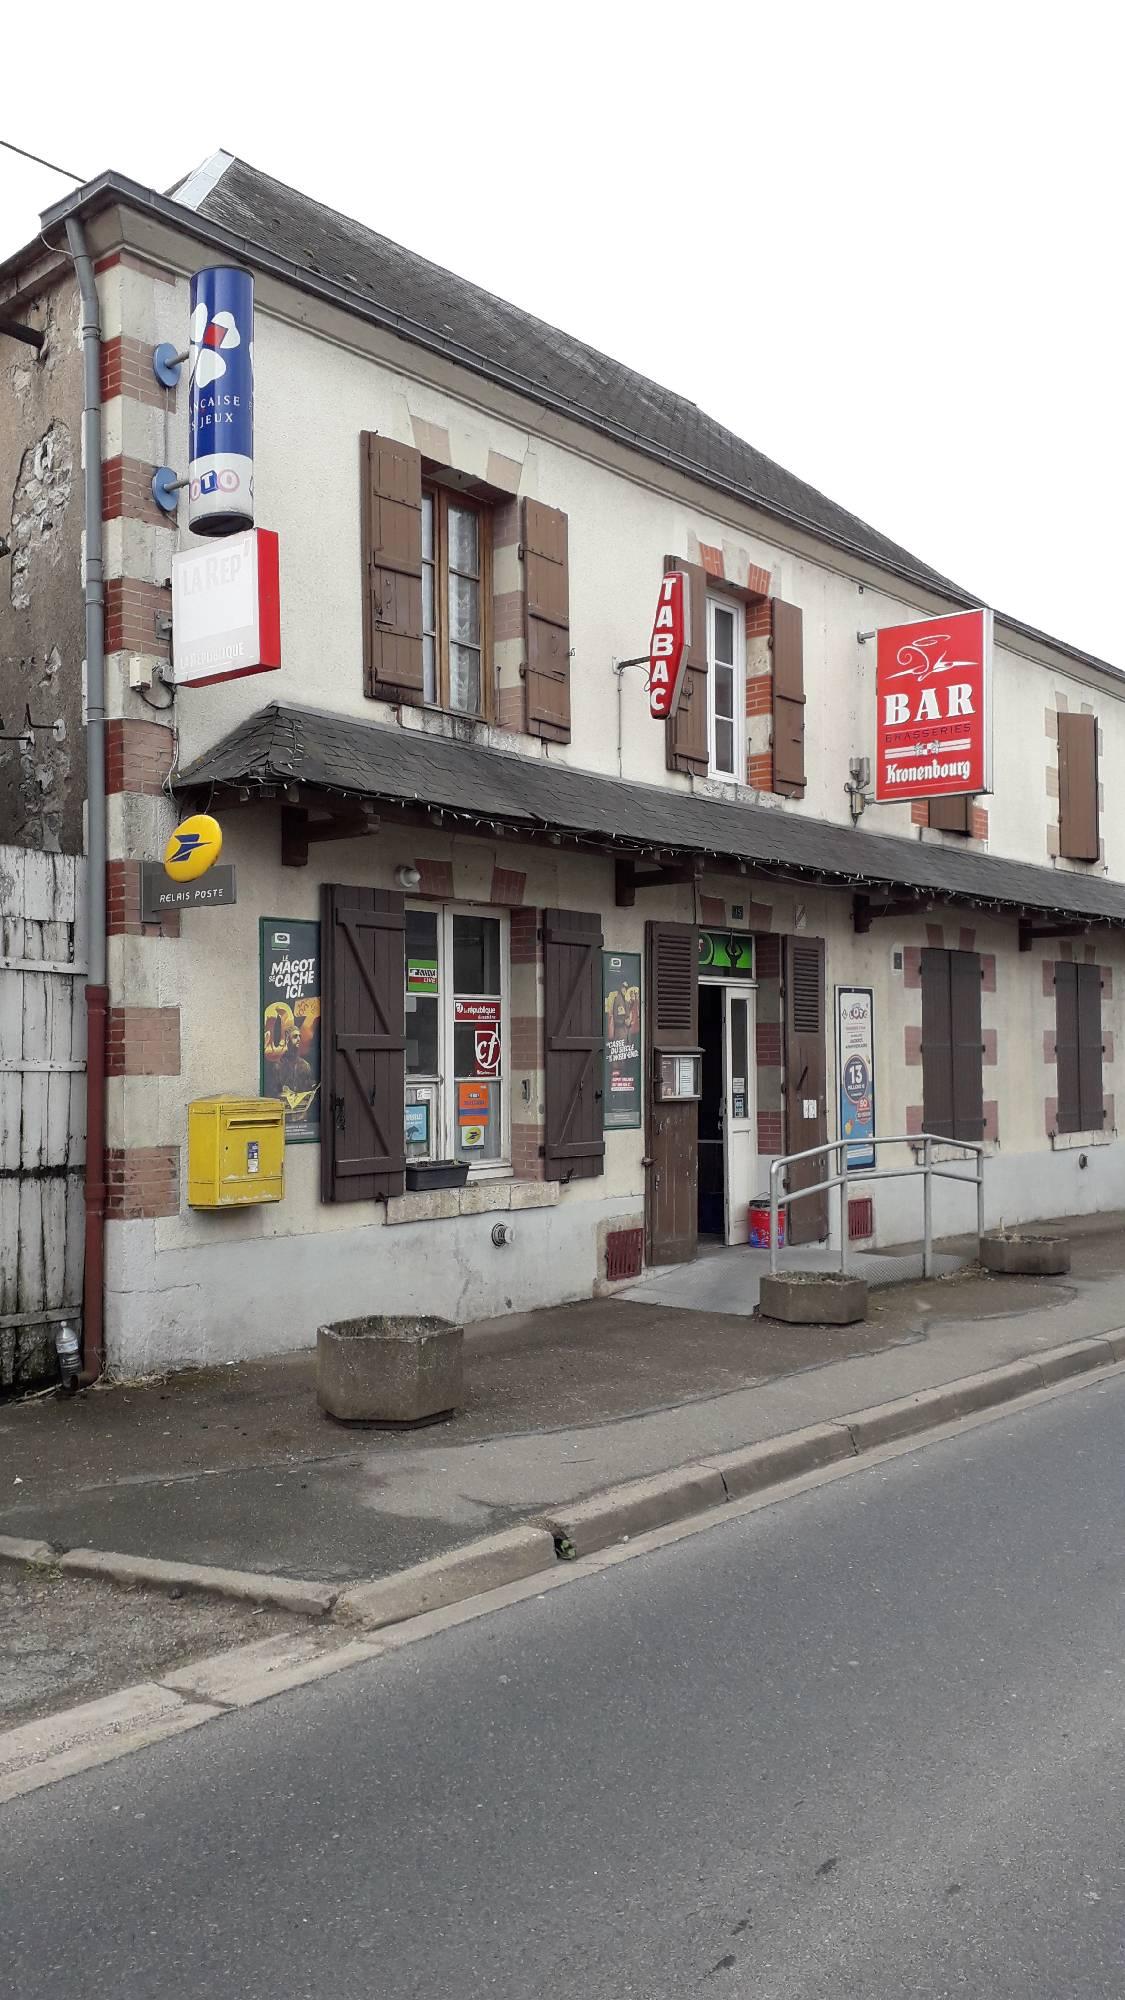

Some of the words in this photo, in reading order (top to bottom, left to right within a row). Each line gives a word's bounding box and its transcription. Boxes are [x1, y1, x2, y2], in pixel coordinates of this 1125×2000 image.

[200, 413, 233, 428] JEUX
[650, 577, 677, 711] TABAC
[883, 683, 976, 726] BAR
[885, 759, 971, 784] Kronenbourg
[160, 891, 190, 903] RELAIS
[194, 888, 224, 899] POSTE
[271, 958, 315, 976] MAGOT
[274, 971, 315, 988] CACHE
[285, 984, 305, 999] ICI.
[849, 1064, 863, 1085] 13
